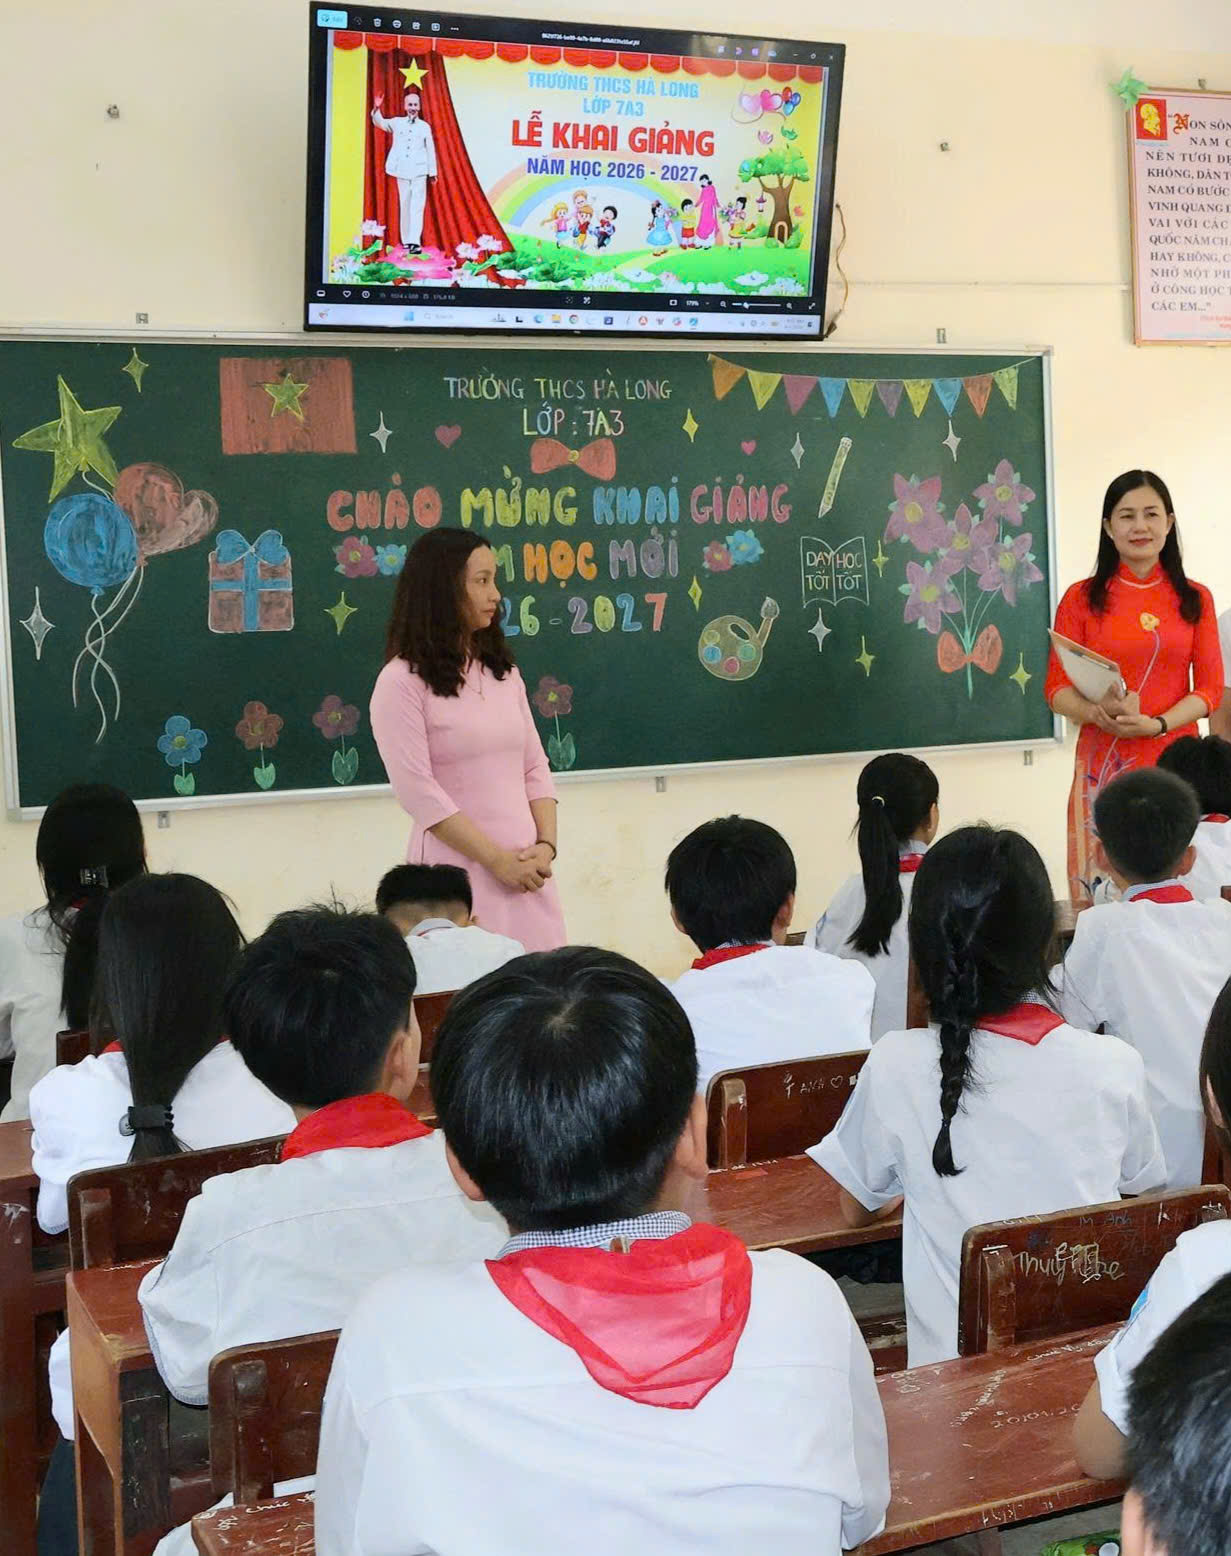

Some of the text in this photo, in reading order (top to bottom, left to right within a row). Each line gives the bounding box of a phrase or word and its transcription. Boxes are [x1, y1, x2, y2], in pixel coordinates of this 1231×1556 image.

[528, 70, 699, 98] TRƯỜNG THCS HÀ LONG
[583, 97, 644, 117] LỚP 7A3
[511, 110, 715, 157] LỄ KHAI GIẢNG
[1190, 137, 1219, 147] NAM
[1146, 150, 1175, 161] NÊN
[527, 155, 565, 175] NĂM
[570, 160, 602, 180] HỌC
[607, 163, 645, 179] 2026
[661, 165, 699, 182] 2027
[1147, 167, 1194, 180] KHÔNG,
[1197, 170, 1221, 180] DÂN
[1147, 185, 1175, 194] NAM
[1178, 183, 1195, 194] CÓ
[1148, 201, 1178, 212] VINH
[1181, 203, 1223, 213] QUANG
[1149, 218, 1170, 228] VAI
[1175, 218, 1198, 229] VỚI
[1202, 218, 1228, 230] CÁC
[1149, 231, 1181, 245] QUỐC
[1150, 252, 1174, 261] HAY
[1162, 283, 1196, 294] CÔNG
[1151, 300, 1176, 311] CÁC
[443, 366, 673, 400] TRƯỜNG THCS HÀ LONG
[523, 401, 565, 436] LỚP
[582, 407, 625, 436] 7A3
[327, 471, 443, 532] CHÀO
[460, 464, 578, 528] MỪNG
[522, 539, 598, 589] HỌC
[500, 594, 540, 637] 26
[567, 592, 668, 635] 2027
